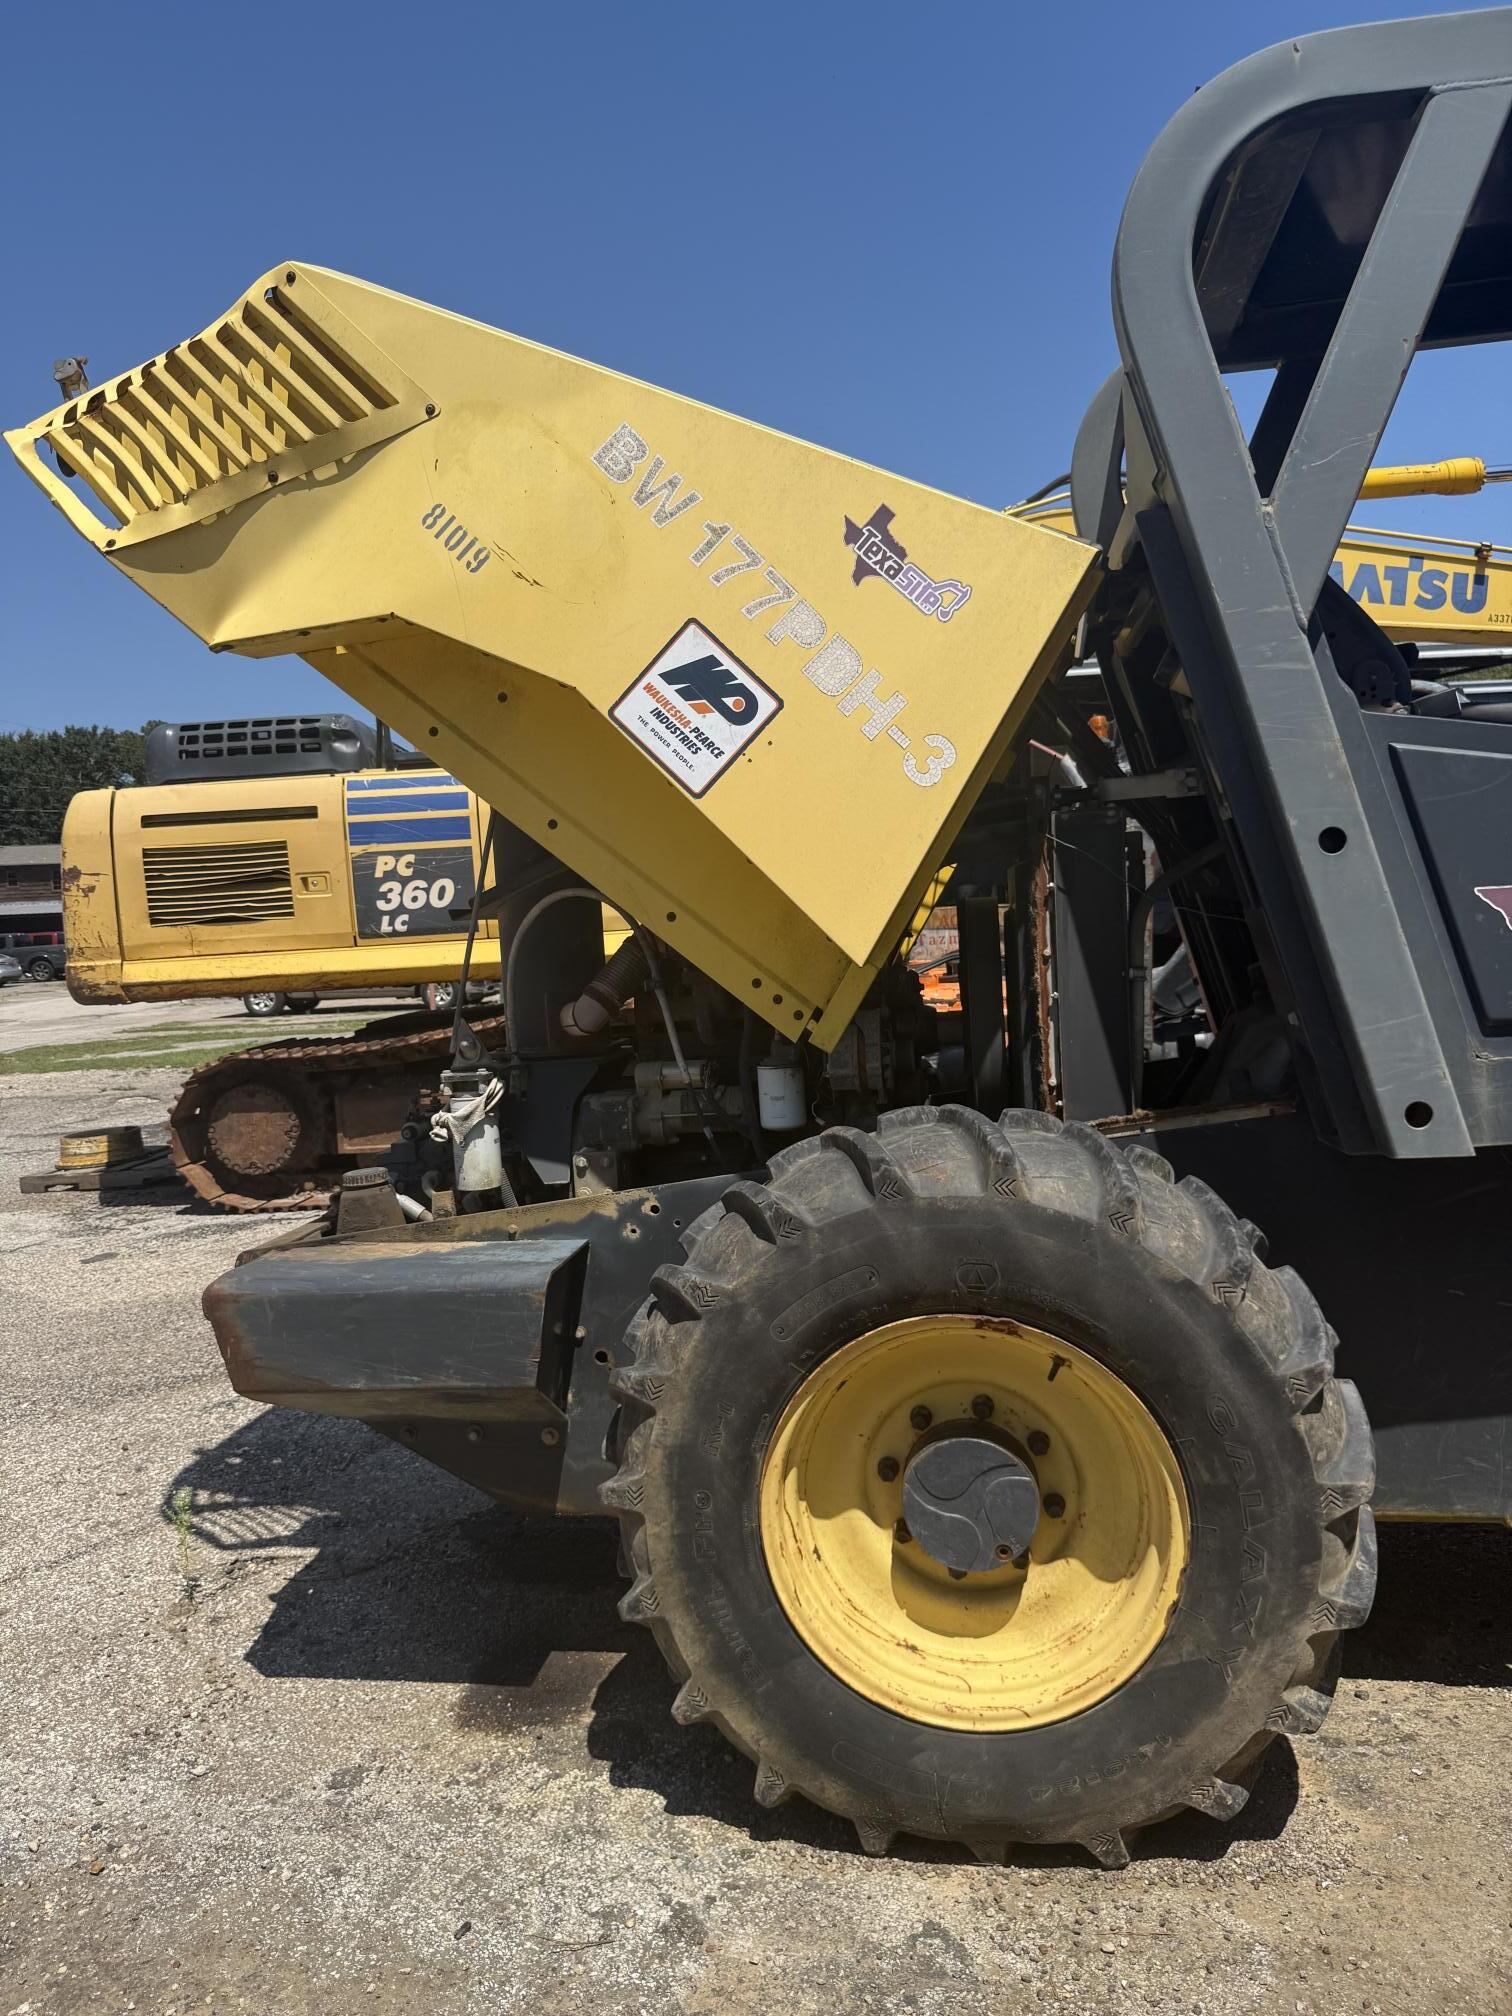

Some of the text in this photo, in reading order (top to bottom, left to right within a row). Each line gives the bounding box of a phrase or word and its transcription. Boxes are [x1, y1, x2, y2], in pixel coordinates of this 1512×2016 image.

[591, 421, 704, 528] BW
[421, 503, 491, 574] 81019
[1488, 613, 1512, 624] A337
[637, 715, 649, 728] THE
[650, 728, 671, 749] POWER
[642, 682, 726, 759] WAUKESHA-PEARCE
[650, 707, 702, 755] INDUSTRIES
[374, 854, 416, 878] PC
[376, 878, 455, 912] 360
[380, 914, 410, 933] LC
[1205, 1391, 1269, 1684] GALAXY
